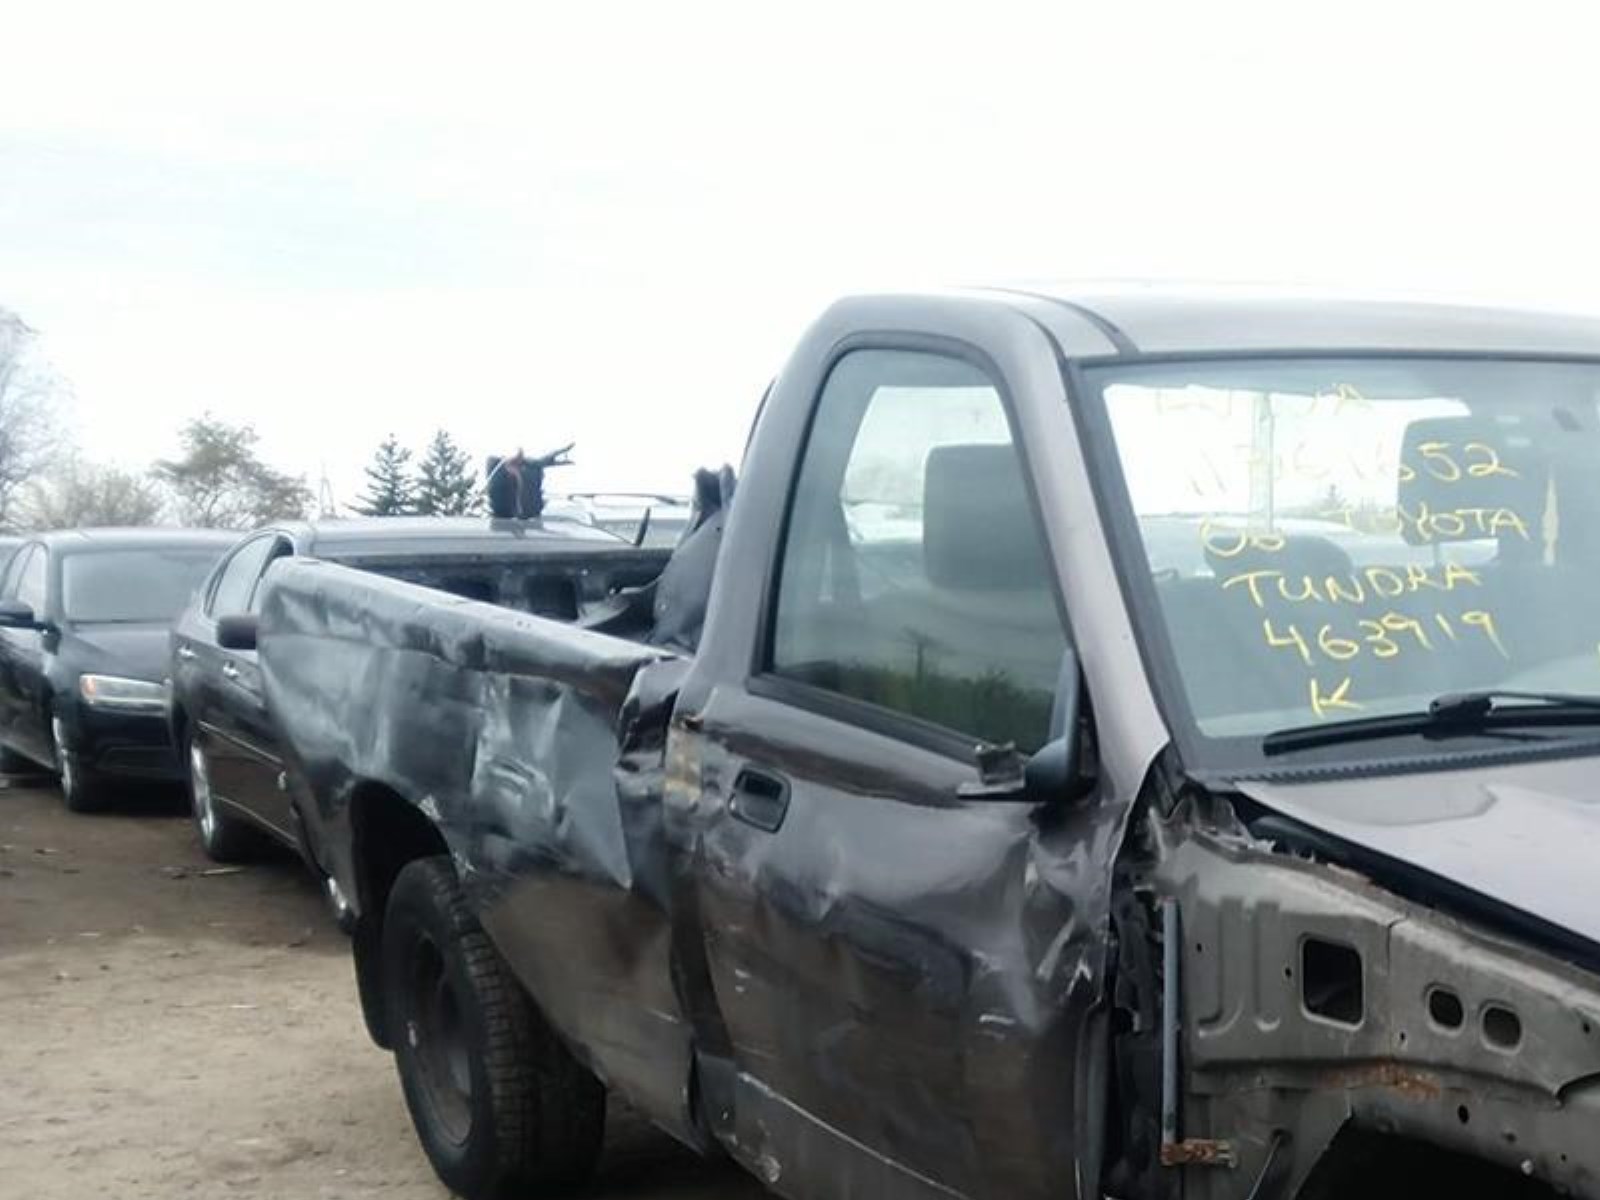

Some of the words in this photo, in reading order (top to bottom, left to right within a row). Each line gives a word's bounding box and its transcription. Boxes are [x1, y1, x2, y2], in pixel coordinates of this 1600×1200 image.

[1222, 562, 1484, 607] TUNDRA
[1263, 609, 1512, 666] 463919
[1309, 676, 1364, 720] K
